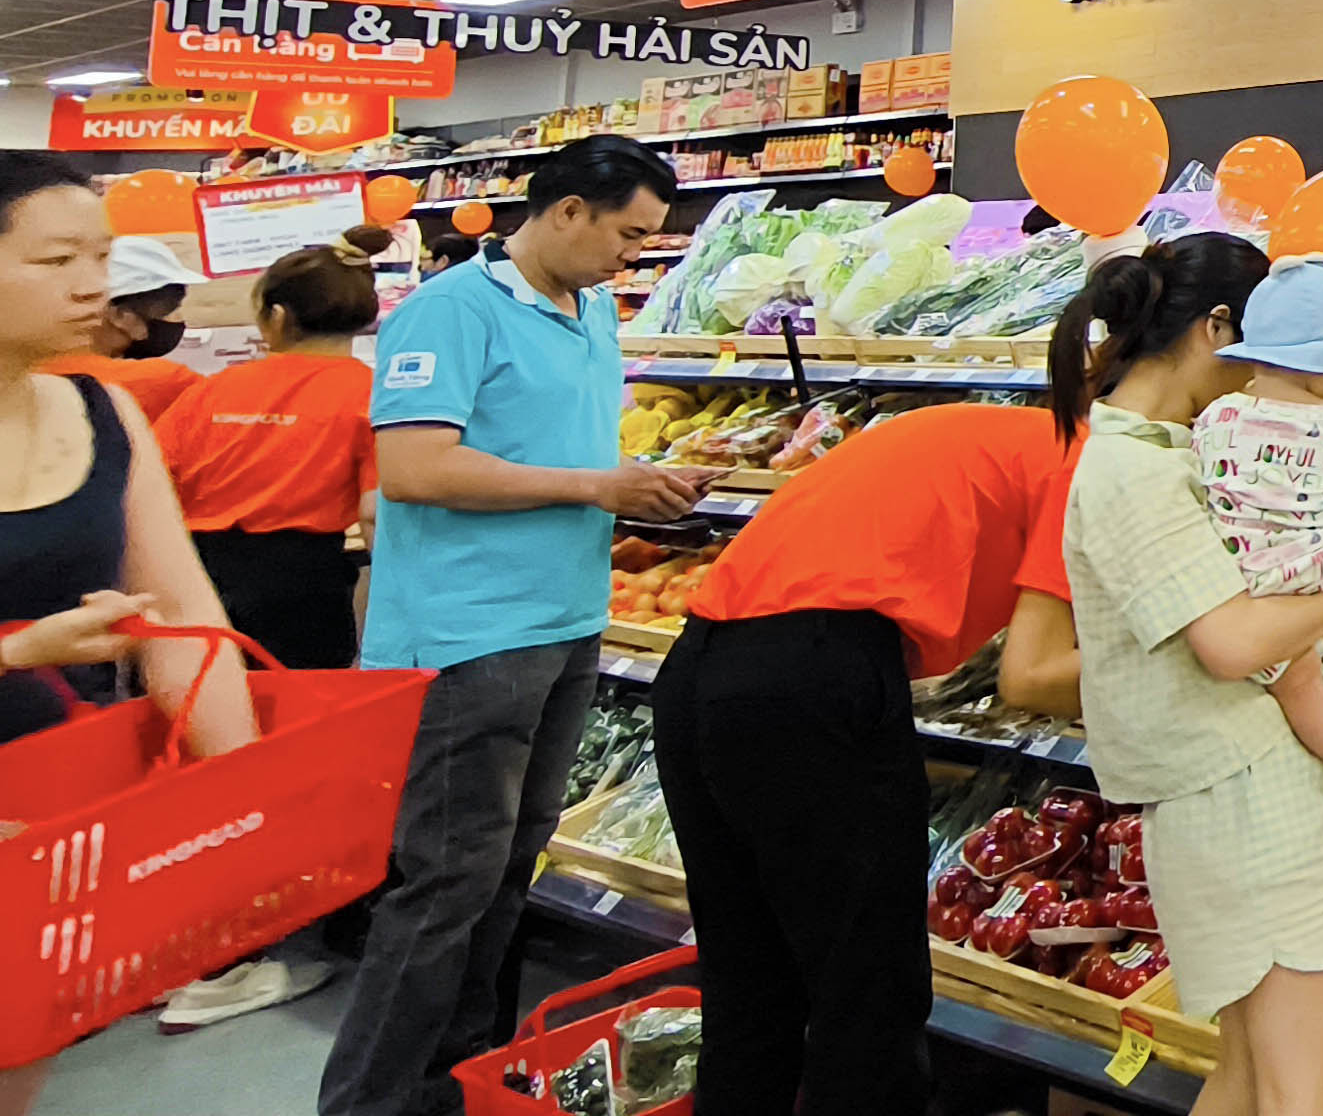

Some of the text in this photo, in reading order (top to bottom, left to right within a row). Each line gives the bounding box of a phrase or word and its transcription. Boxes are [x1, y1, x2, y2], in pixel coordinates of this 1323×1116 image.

[347, 5, 392, 44] &
[598, 16, 692, 64] HẢI
[708, 24, 809, 71] SẢN
[82, 112, 202, 140] KHUYẾN
